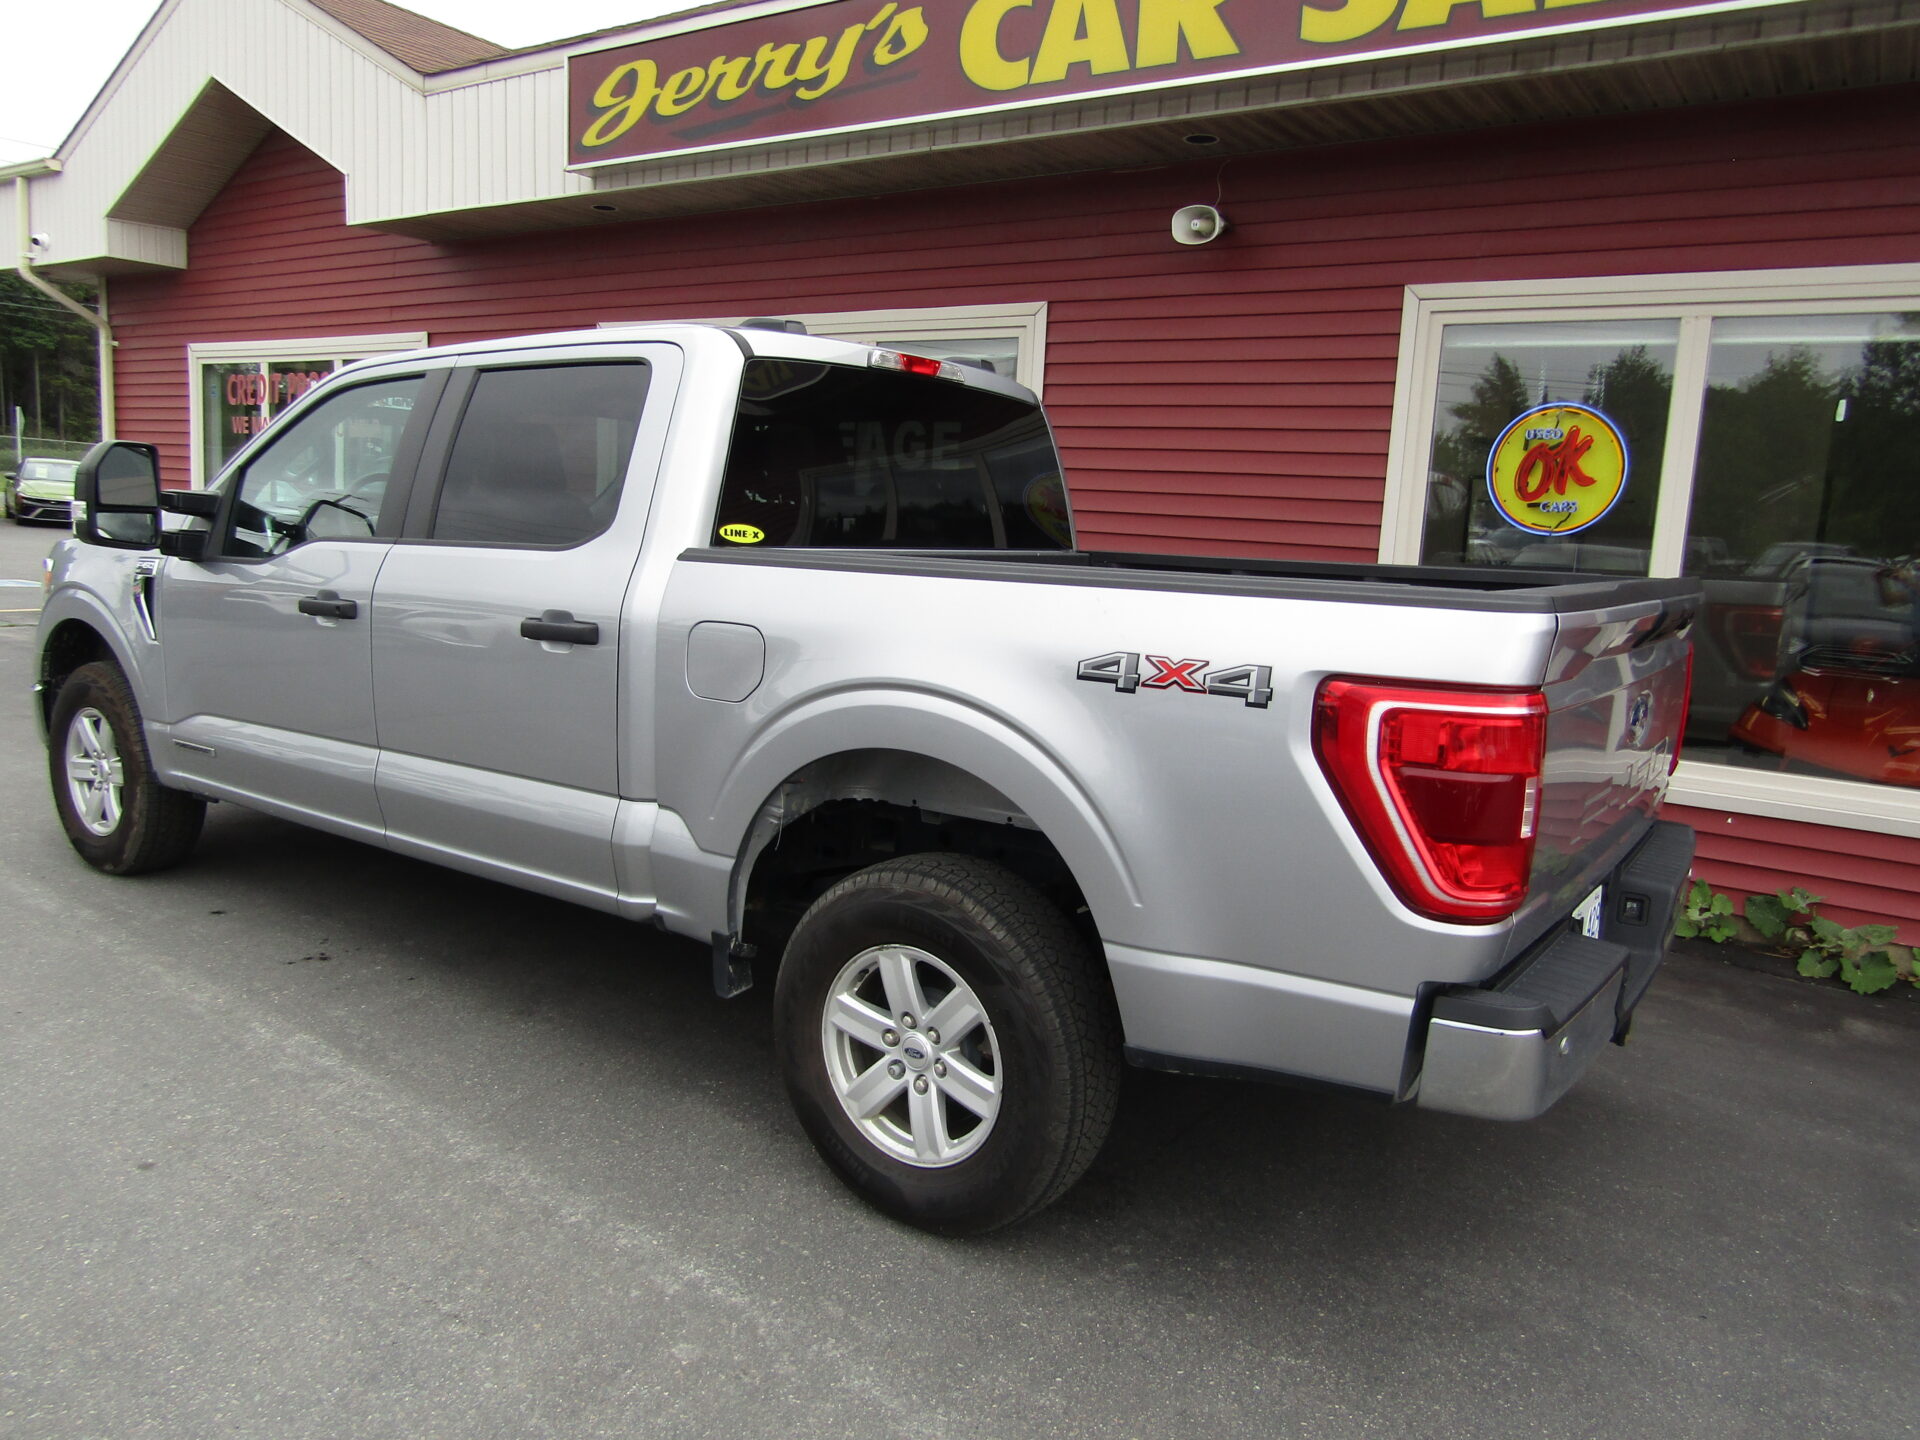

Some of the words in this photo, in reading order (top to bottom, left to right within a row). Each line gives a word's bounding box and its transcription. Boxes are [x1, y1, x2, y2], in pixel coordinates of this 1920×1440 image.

[580, 2, 929, 148] Jerry's
[958, 0, 1240, 92] CAR
[227, 373, 282, 406] CREDIT
[287, 371, 329, 404] PRO
[232, 416, 249, 434] WE
[251, 416, 272, 434] MA
[1525, 427, 1564, 441] USED
[1514, 425, 1597, 502] OK
[1539, 500, 1579, 513] CARS
[724, 528, 760, 539] LINE-X
